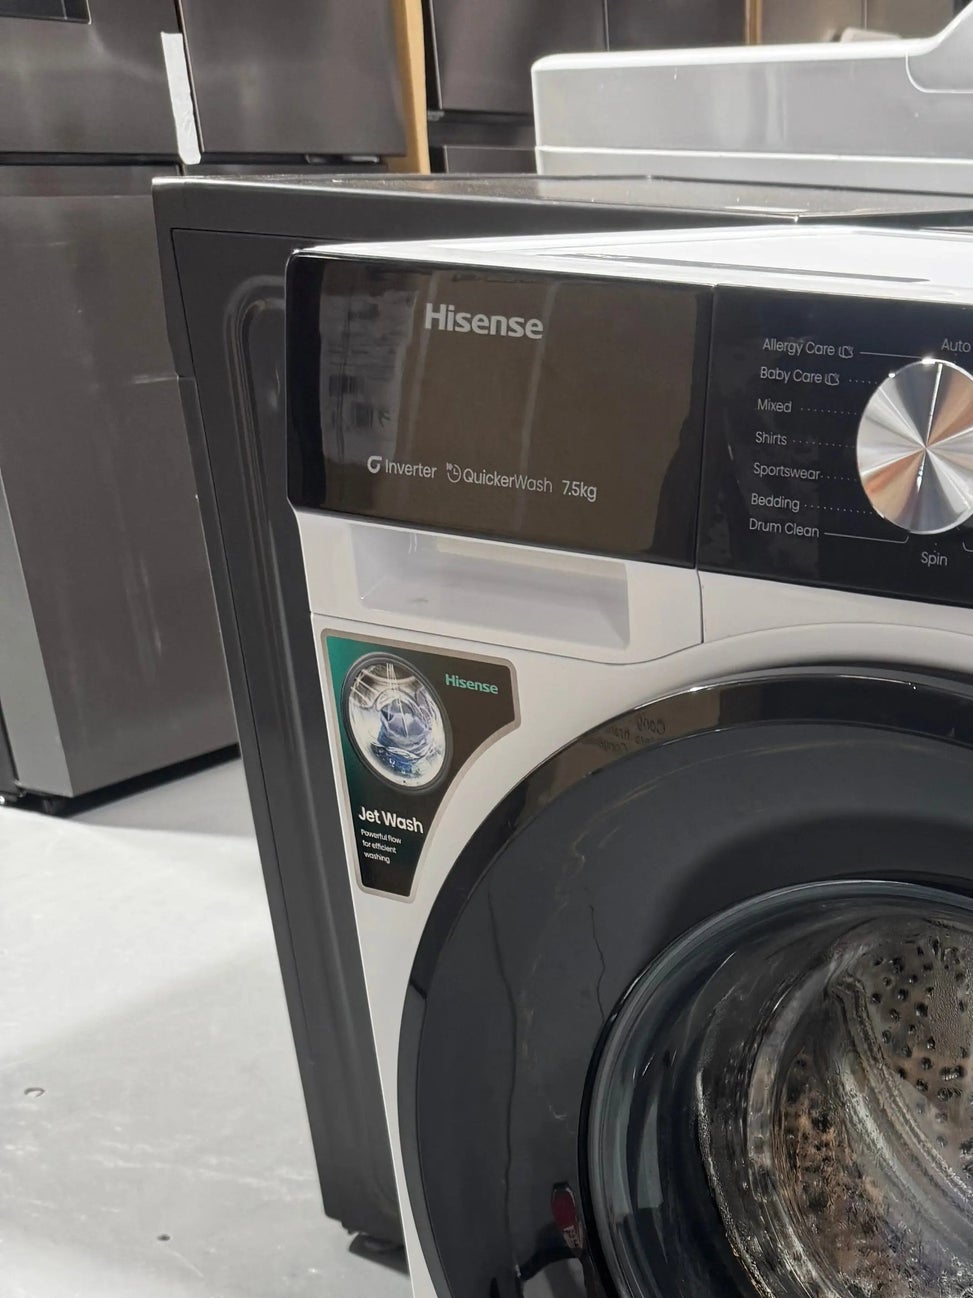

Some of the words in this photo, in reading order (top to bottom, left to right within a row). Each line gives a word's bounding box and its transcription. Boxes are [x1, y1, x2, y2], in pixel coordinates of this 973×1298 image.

[424, 303, 544, 340] Hisense
[762, 338, 803, 355] Allergy
[806, 341, 835, 355] Care
[941, 338, 971, 353] Auto
[760, 366, 790, 383] Baby
[793, 369, 822, 383] Care
[757, 398, 792, 413] Mixed
[755, 431, 787, 445] Shirts
[753, 462, 820, 480] Sportswear
[385, 459, 437, 479] Inverter
[462, 468, 553, 493] QuickerWash
[561, 480, 597, 502] 7.5kg
[751, 493, 800, 512] Bedding
[749, 518, 782, 533] Drum
[784, 522, 819, 538] Clean
[920, 552, 948, 567] Spin
[445, 673, 499, 695] Hisense
[358, 806, 381, 824] Jet
[381, 810, 424, 834] Wash
[360, 828, 388, 841] Powerful
[372, 842, 397, 854] efficient
[363, 852, 390, 864] washing
